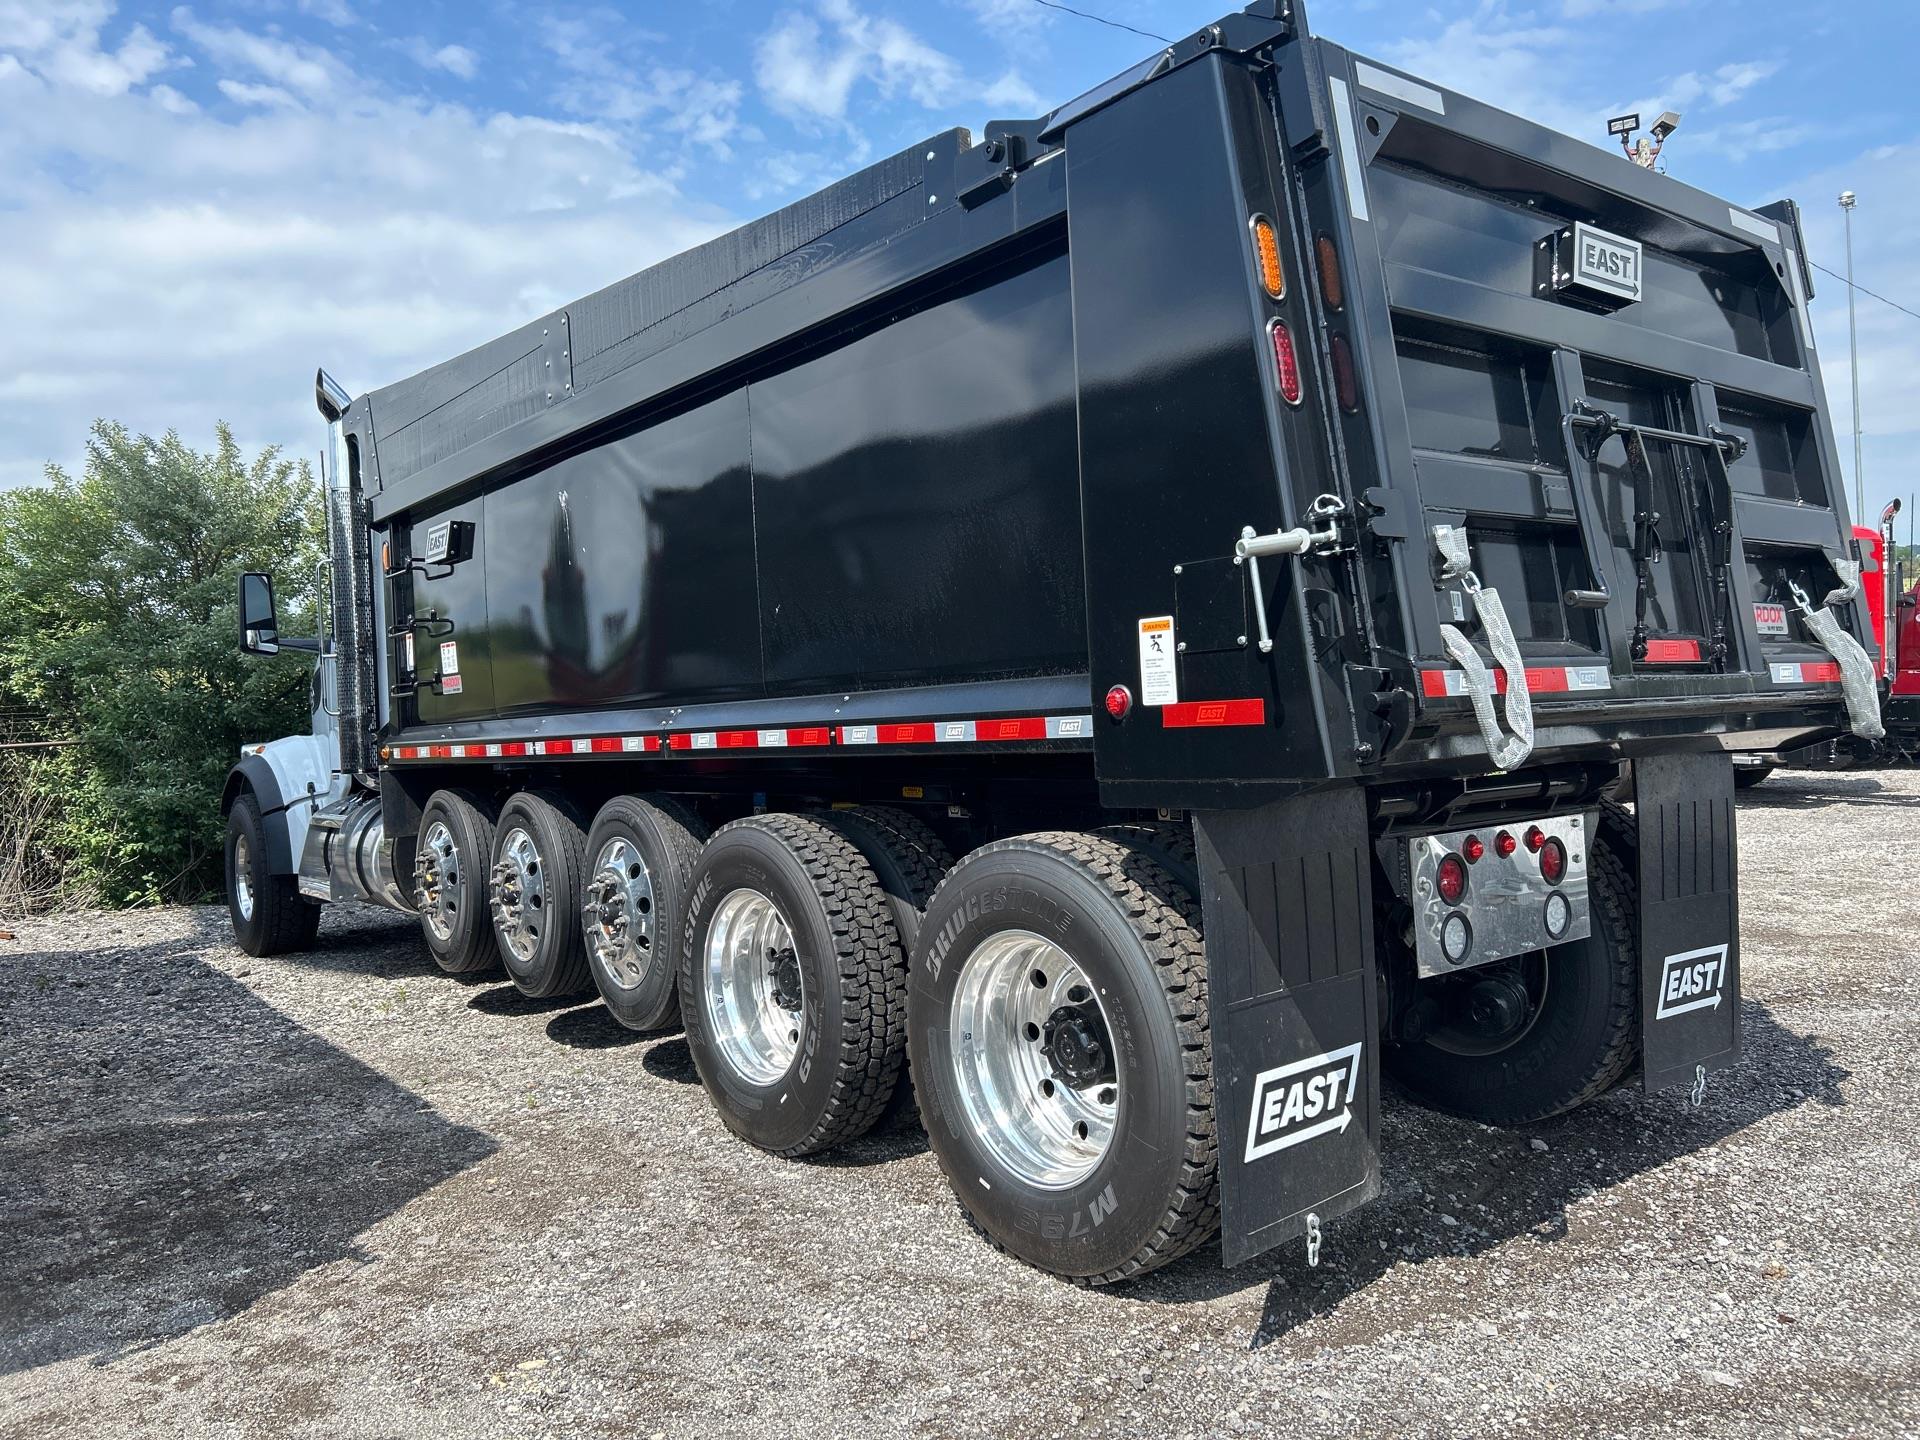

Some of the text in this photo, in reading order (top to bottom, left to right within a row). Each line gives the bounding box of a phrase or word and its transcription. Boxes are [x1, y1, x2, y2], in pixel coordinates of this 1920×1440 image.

[1585, 243, 1631, 279] EAST
[429, 533, 446, 551] EAST
[1756, 606, 1783, 623] RDOX
[1581, 673, 1595, 685] EAST
[1201, 708, 1222, 718] EAST
[947, 727, 963, 736] EAST
[1001, 723, 1019, 734] EAST
[1061, 721, 1080, 731] EAST
[925, 886, 1074, 983] BRIDGESTONE
[1667, 960, 1718, 1002] EAST
[1260, 1067, 1347, 1135] EAST
